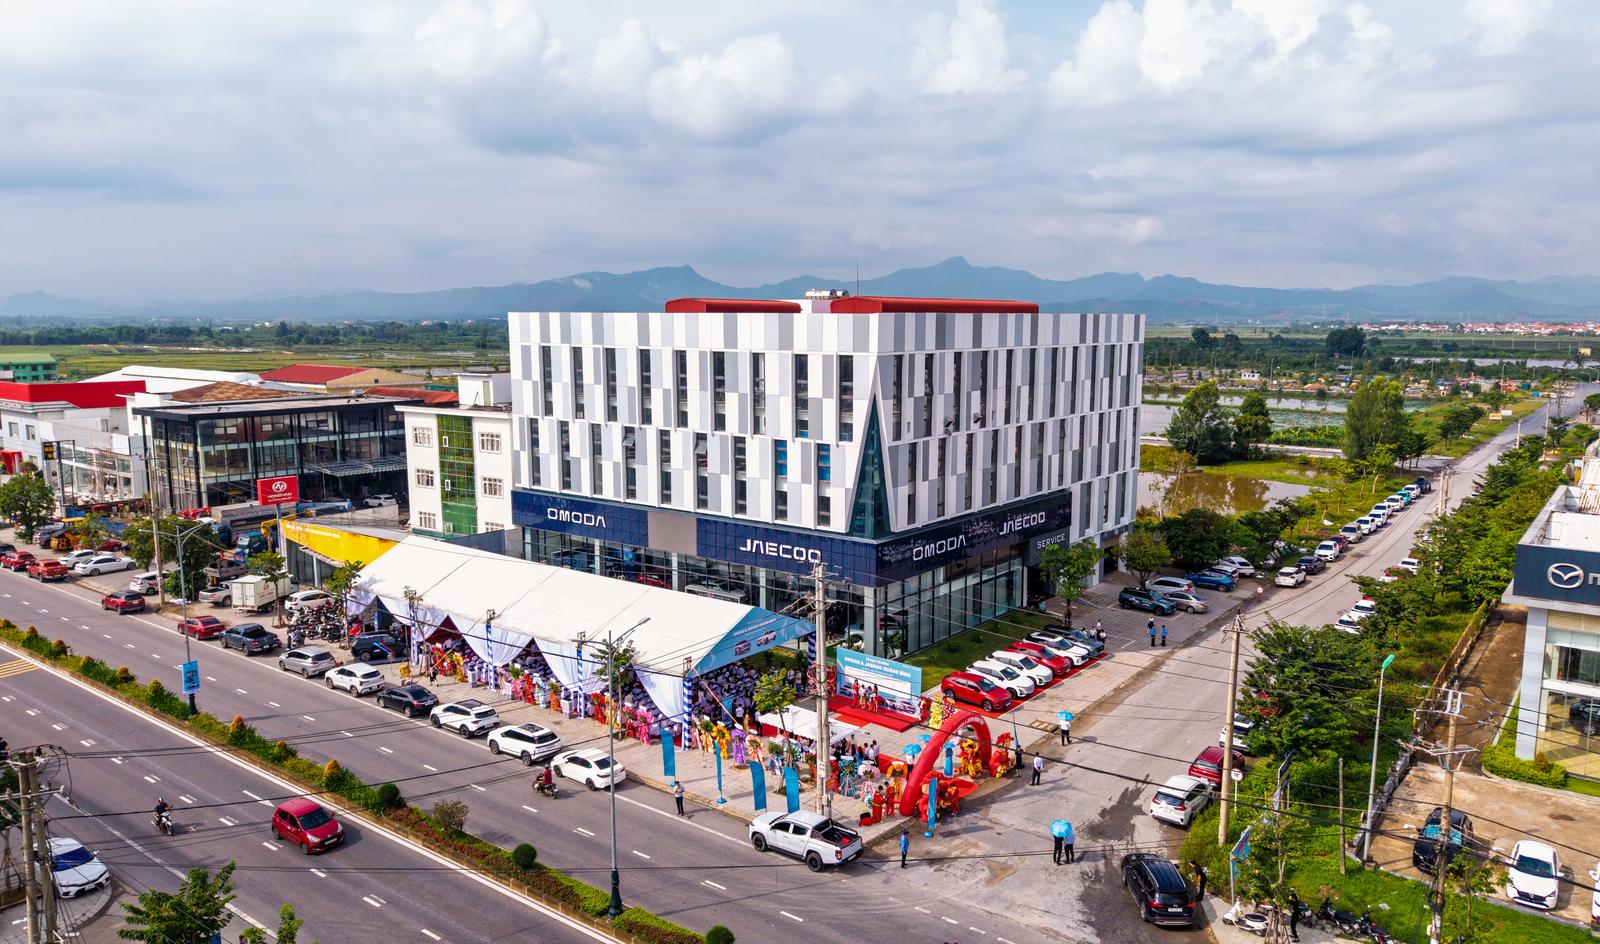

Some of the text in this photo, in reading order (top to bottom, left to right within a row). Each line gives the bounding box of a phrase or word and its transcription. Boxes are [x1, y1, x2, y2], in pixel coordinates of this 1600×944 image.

[547, 508, 606, 528] OMODA
[1000, 511, 1046, 535] JAECOO
[739, 539, 821, 563] JAECOO
[912, 534, 966, 561] OMODA
[1037, 533, 1066, 549] SERVICE
